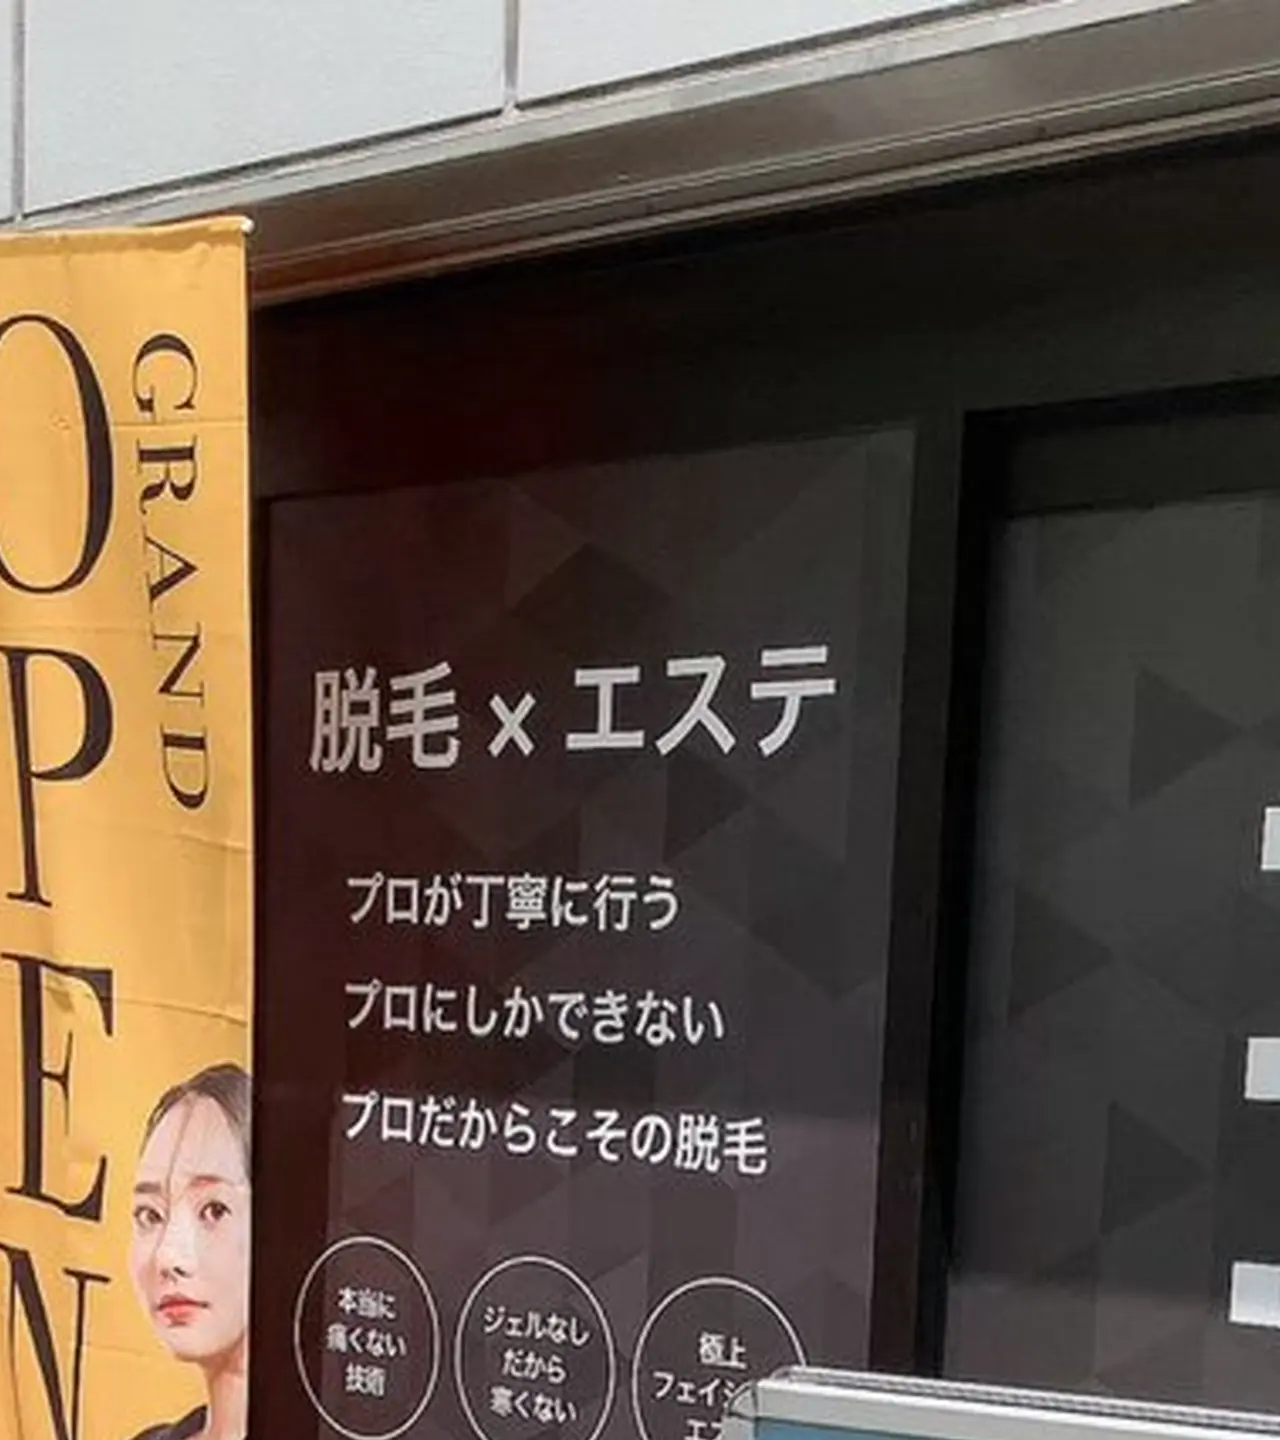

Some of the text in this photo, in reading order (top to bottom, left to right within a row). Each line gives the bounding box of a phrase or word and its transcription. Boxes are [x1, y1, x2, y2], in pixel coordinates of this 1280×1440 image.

[131, 332, 211, 810] GRAND
[308, 661, 462, 774] 脱毛
[565, 645, 837, 758] エステ
[346, 872, 680, 932] プロが丁寧に行う
[344, 978, 725, 1046] プロにしかできない
[341, 1091, 769, 1176] プロだからこその脱毛
[338, 1286, 397, 1320] 本当に
[326, 1323, 407, 1357] 痛くない
[483, 1305, 590, 1347] ジェルなし
[502, 1348, 567, 1384] だから
[699, 1331, 748, 1370] 極上
[344, 1362, 387, 1396] 技術
[489, 1386, 577, 1424] 寒くない
